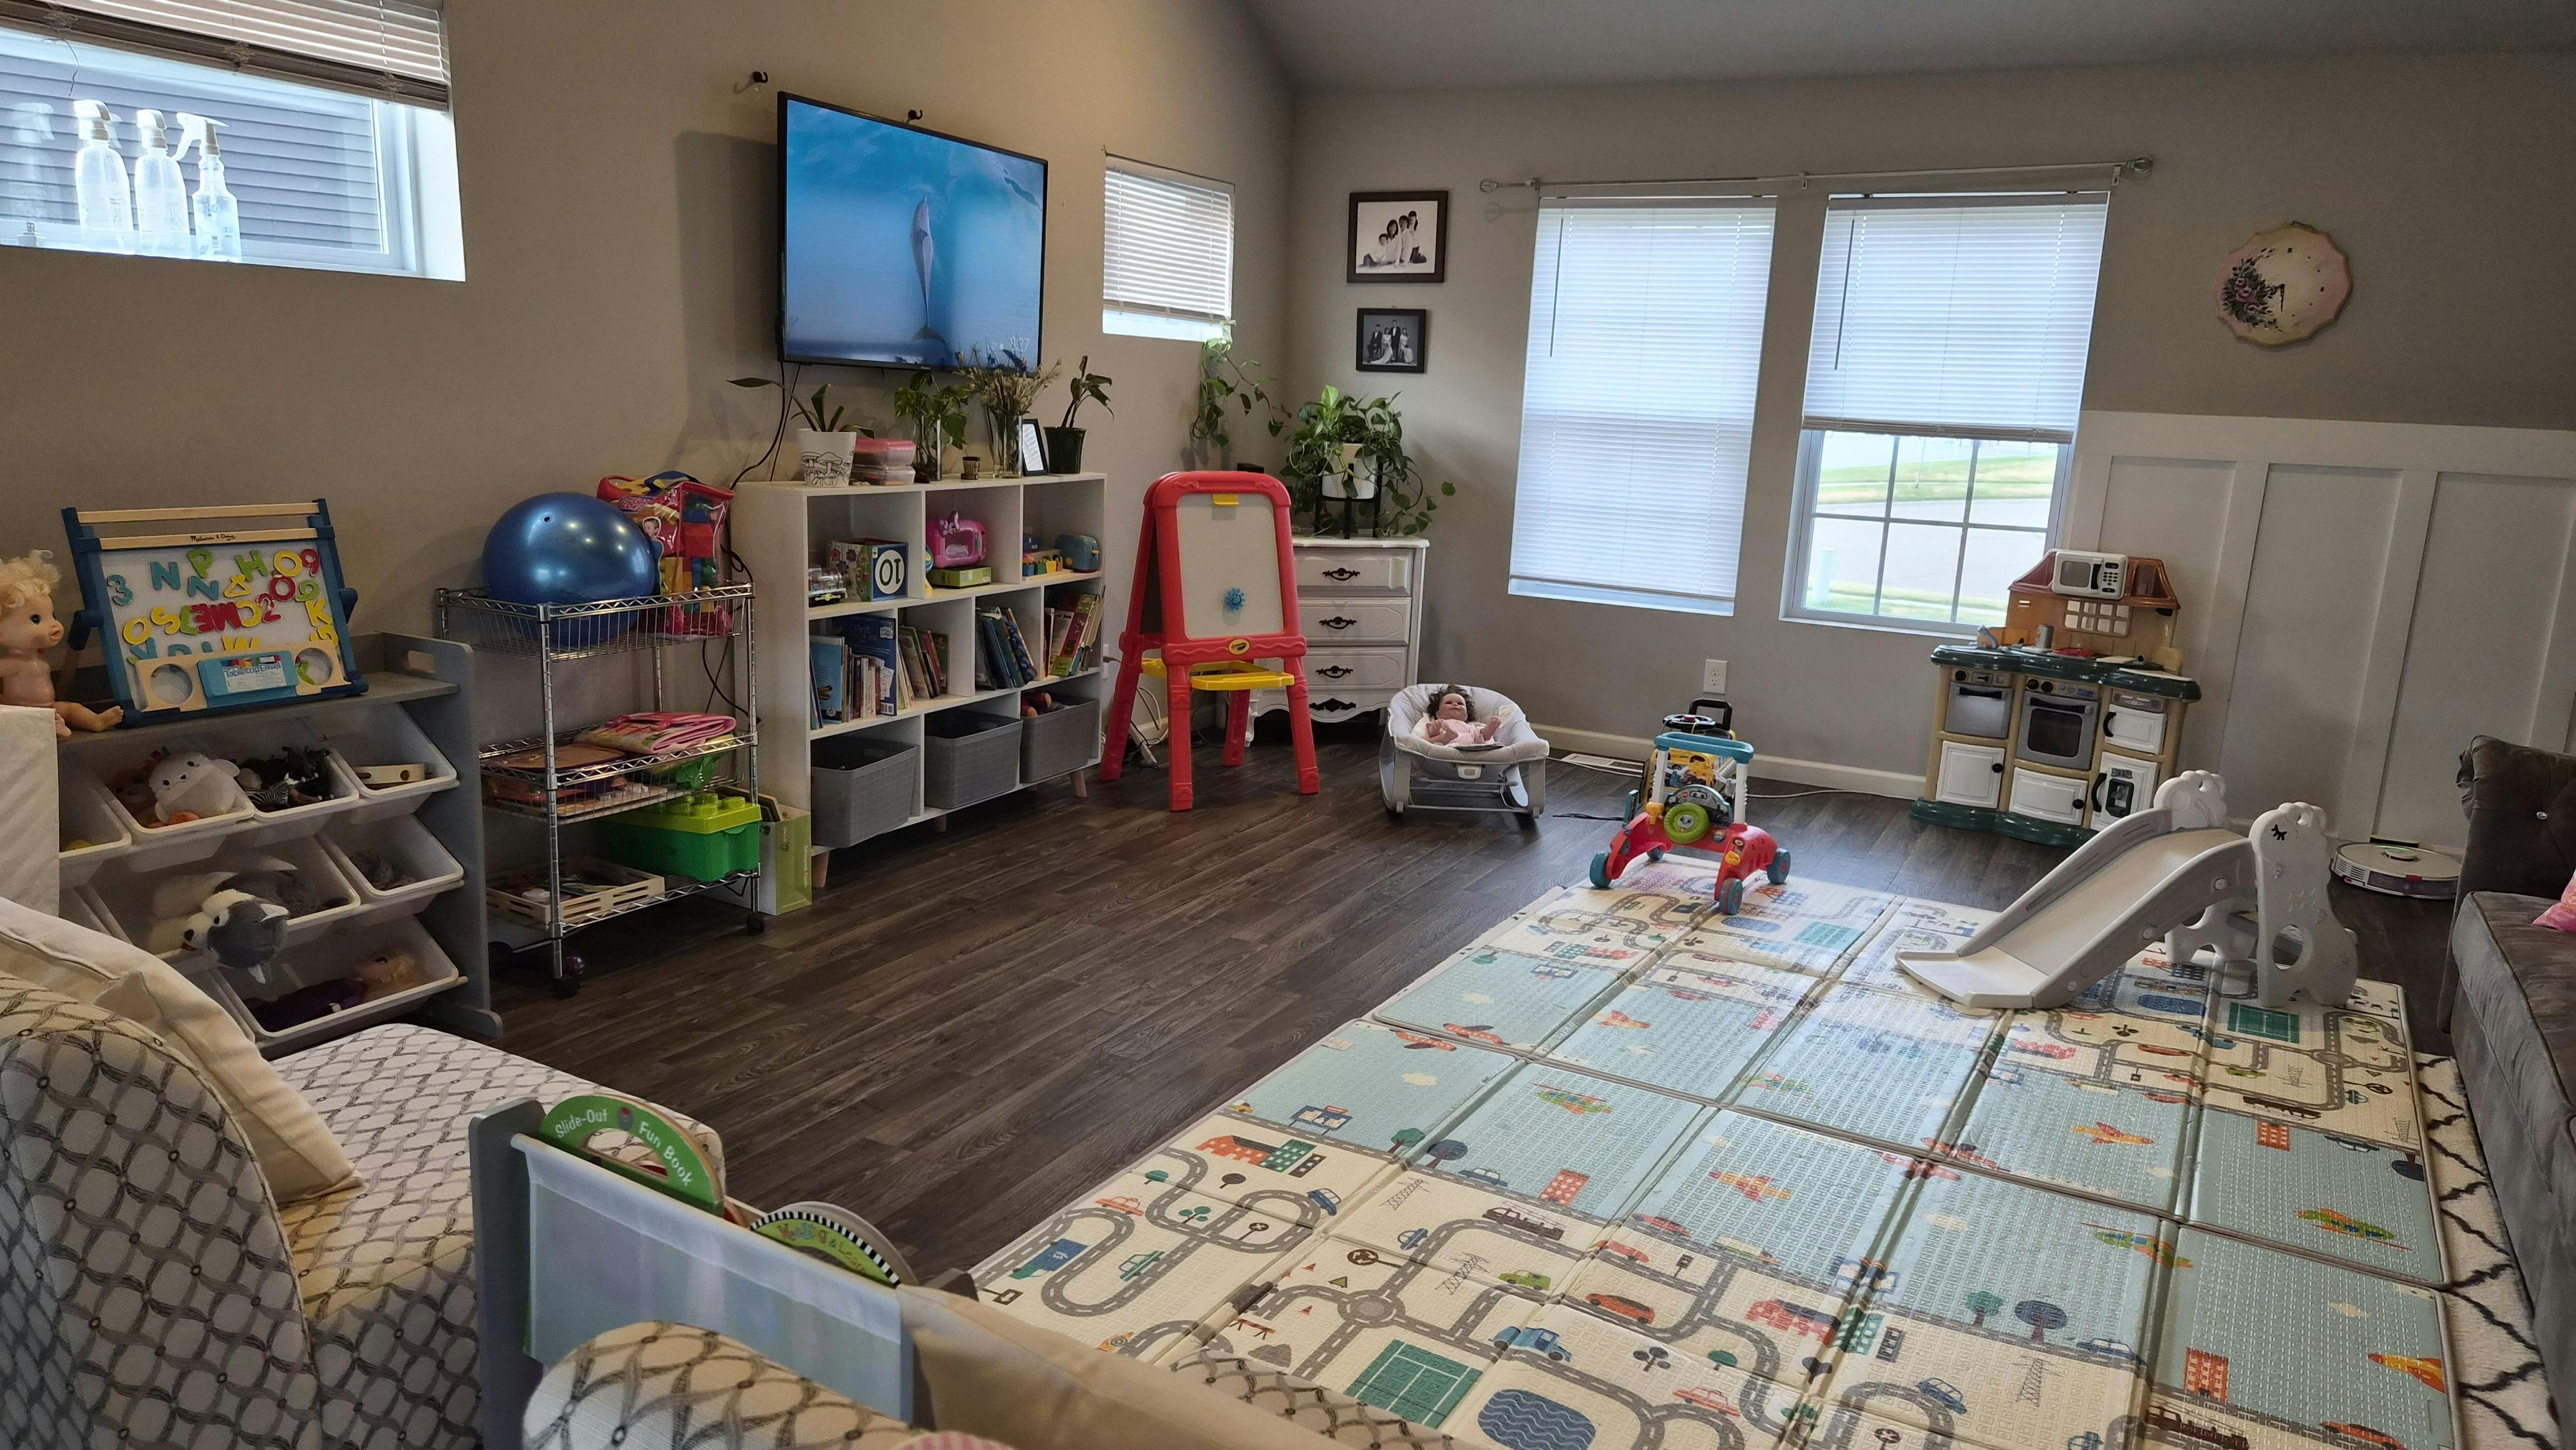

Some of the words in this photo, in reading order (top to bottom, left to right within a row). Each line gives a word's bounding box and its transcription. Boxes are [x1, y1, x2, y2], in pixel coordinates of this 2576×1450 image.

[107, 574, 133, 607] 3
[555, 1109, 609, 1138] Slide-Out
[639, 1121, 661, 1148] Fun
[663, 1145, 692, 1186] Book
